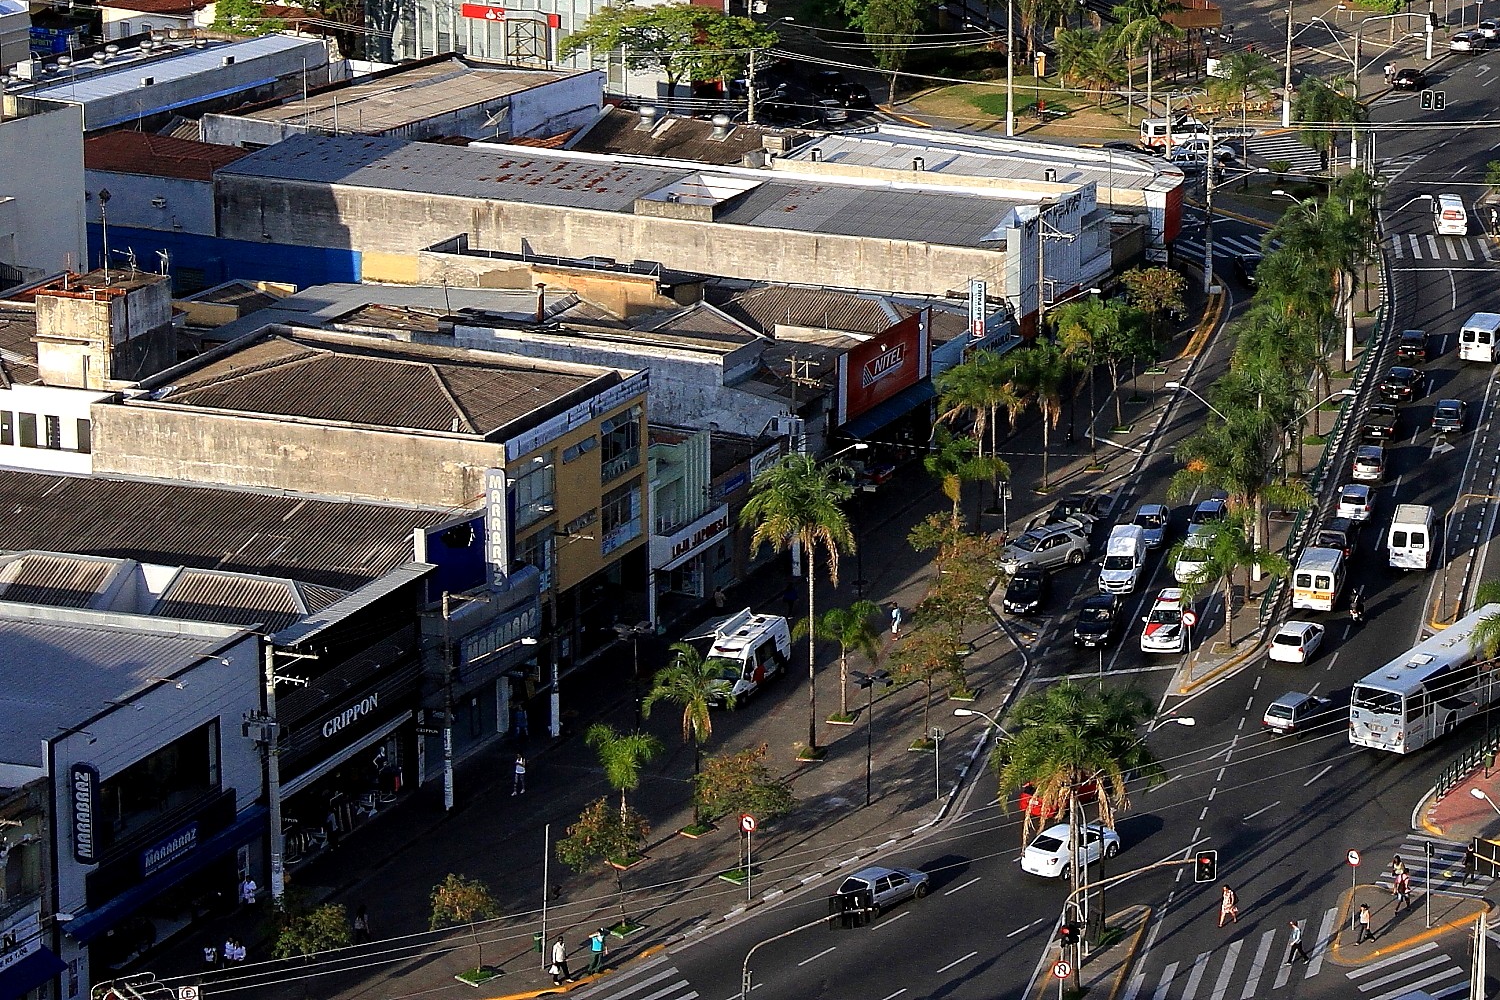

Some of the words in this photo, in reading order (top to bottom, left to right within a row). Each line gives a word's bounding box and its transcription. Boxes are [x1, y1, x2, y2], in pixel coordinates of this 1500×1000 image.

[874, 348, 902, 370] NITEL
[488, 474, 503, 586] MARABRAZ
[322, 692, 379, 738] GRIPPON
[75, 771, 92, 858] MARABRAZ
